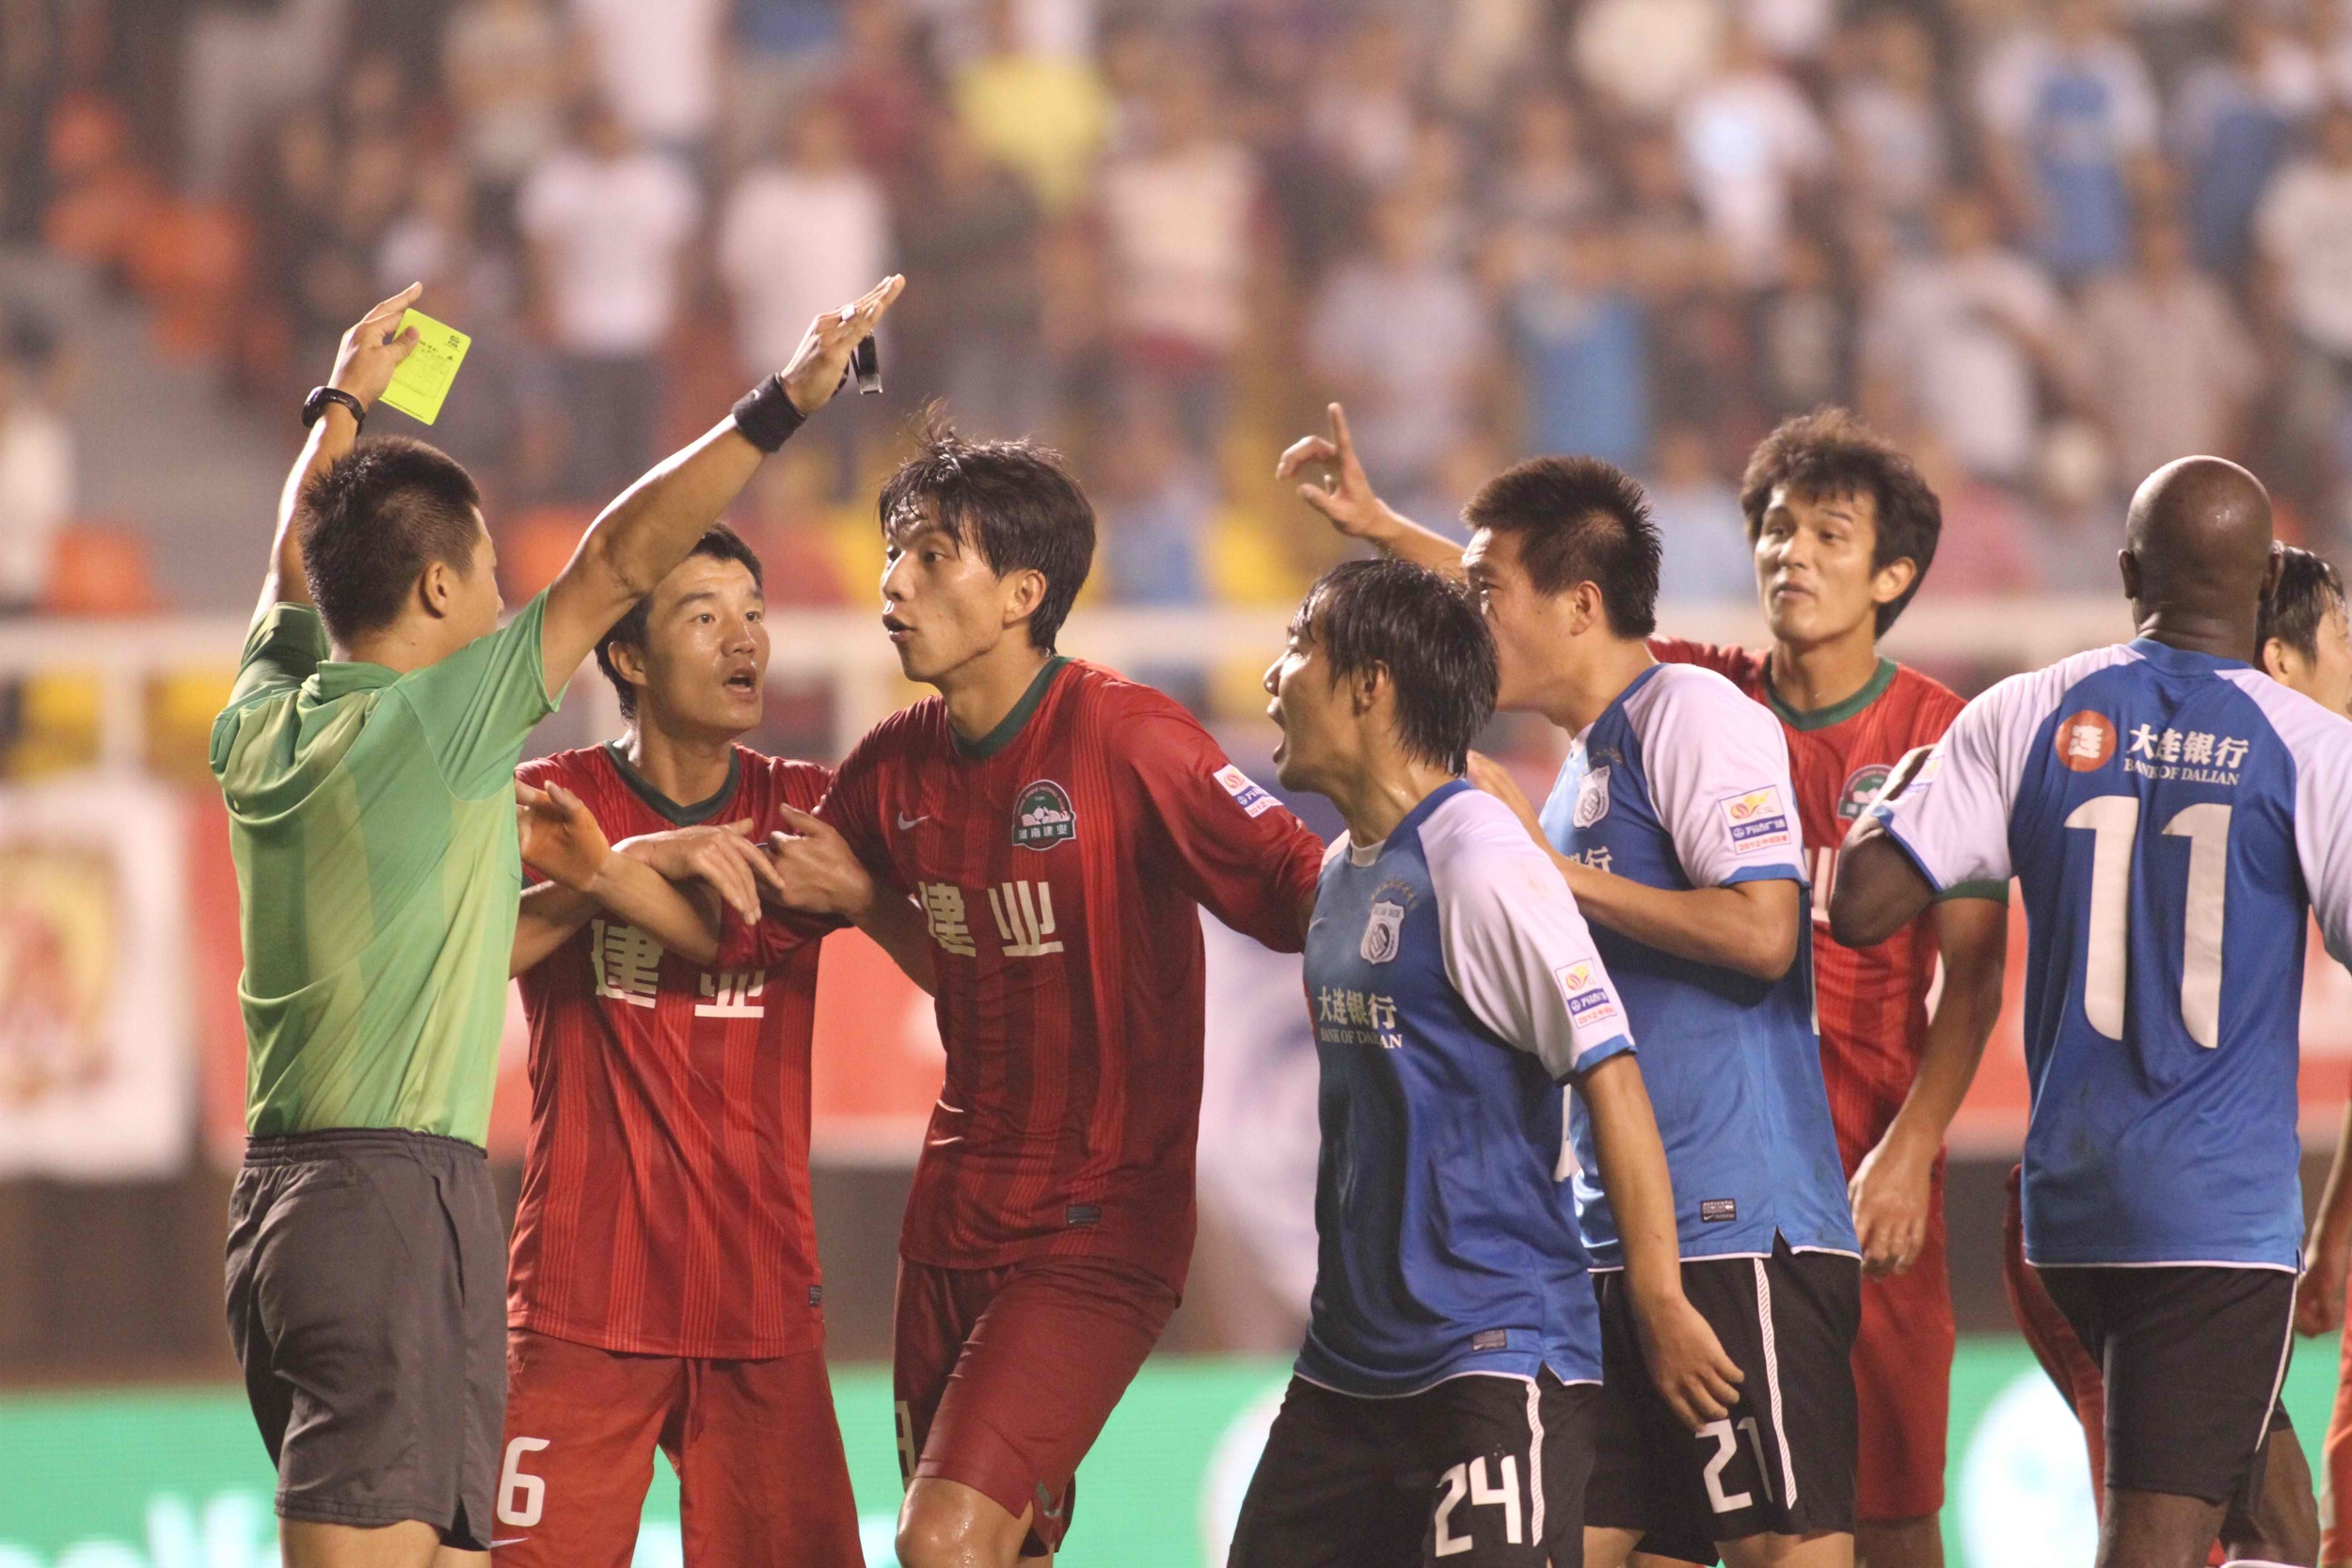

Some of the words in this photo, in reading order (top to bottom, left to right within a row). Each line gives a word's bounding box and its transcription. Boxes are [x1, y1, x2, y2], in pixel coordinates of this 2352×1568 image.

[2123, 758, 2158, 780] BANK
[2159, 766, 2179, 780] OF
[2181, 767, 2239, 786] DALIAN
[2126, 722, 2249, 769] 大连银行
[917, 879, 1065, 958] 建业
[2063, 795, 2233, 1050] 11
[591, 918, 766, 1019] 建业
[1318, 986, 1397, 1031] 大连银行
[1320, 1027, 1340, 1043] BANK
[1340, 1028, 1354, 1044] OF
[1357, 1029, 1403, 1049] DALIAN
[497, 1436, 551, 1528] 6
[1435, 1455, 1522, 1558] 24
[1694, 1417, 1773, 1513] 21
